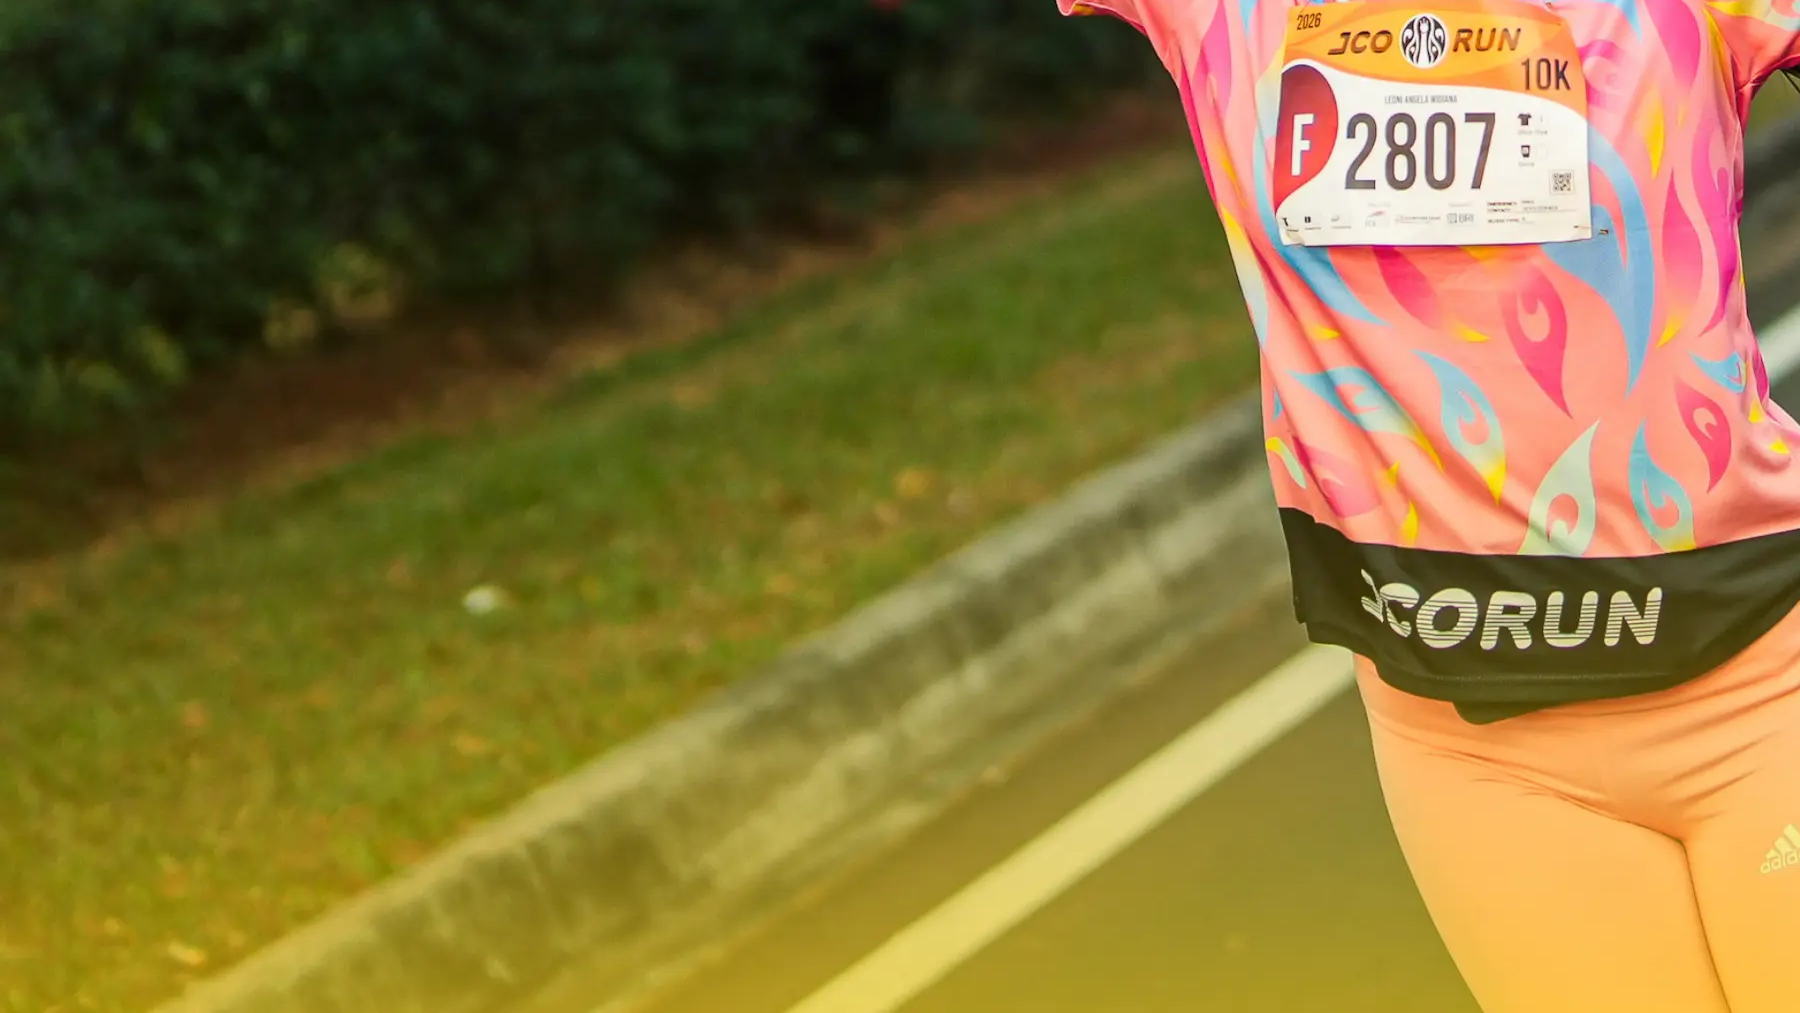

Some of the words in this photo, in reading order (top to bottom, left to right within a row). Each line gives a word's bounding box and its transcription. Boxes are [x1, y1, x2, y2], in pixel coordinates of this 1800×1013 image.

[1296, 12, 1322, 30] 2026
[1327, 30, 1393, 56] JCO
[1452, 27, 1522, 53] RUN
[1521, 58, 1571, 91] 10K
[1291, 113, 1315, 176] F
[1344, 112, 1496, 191] 2807
